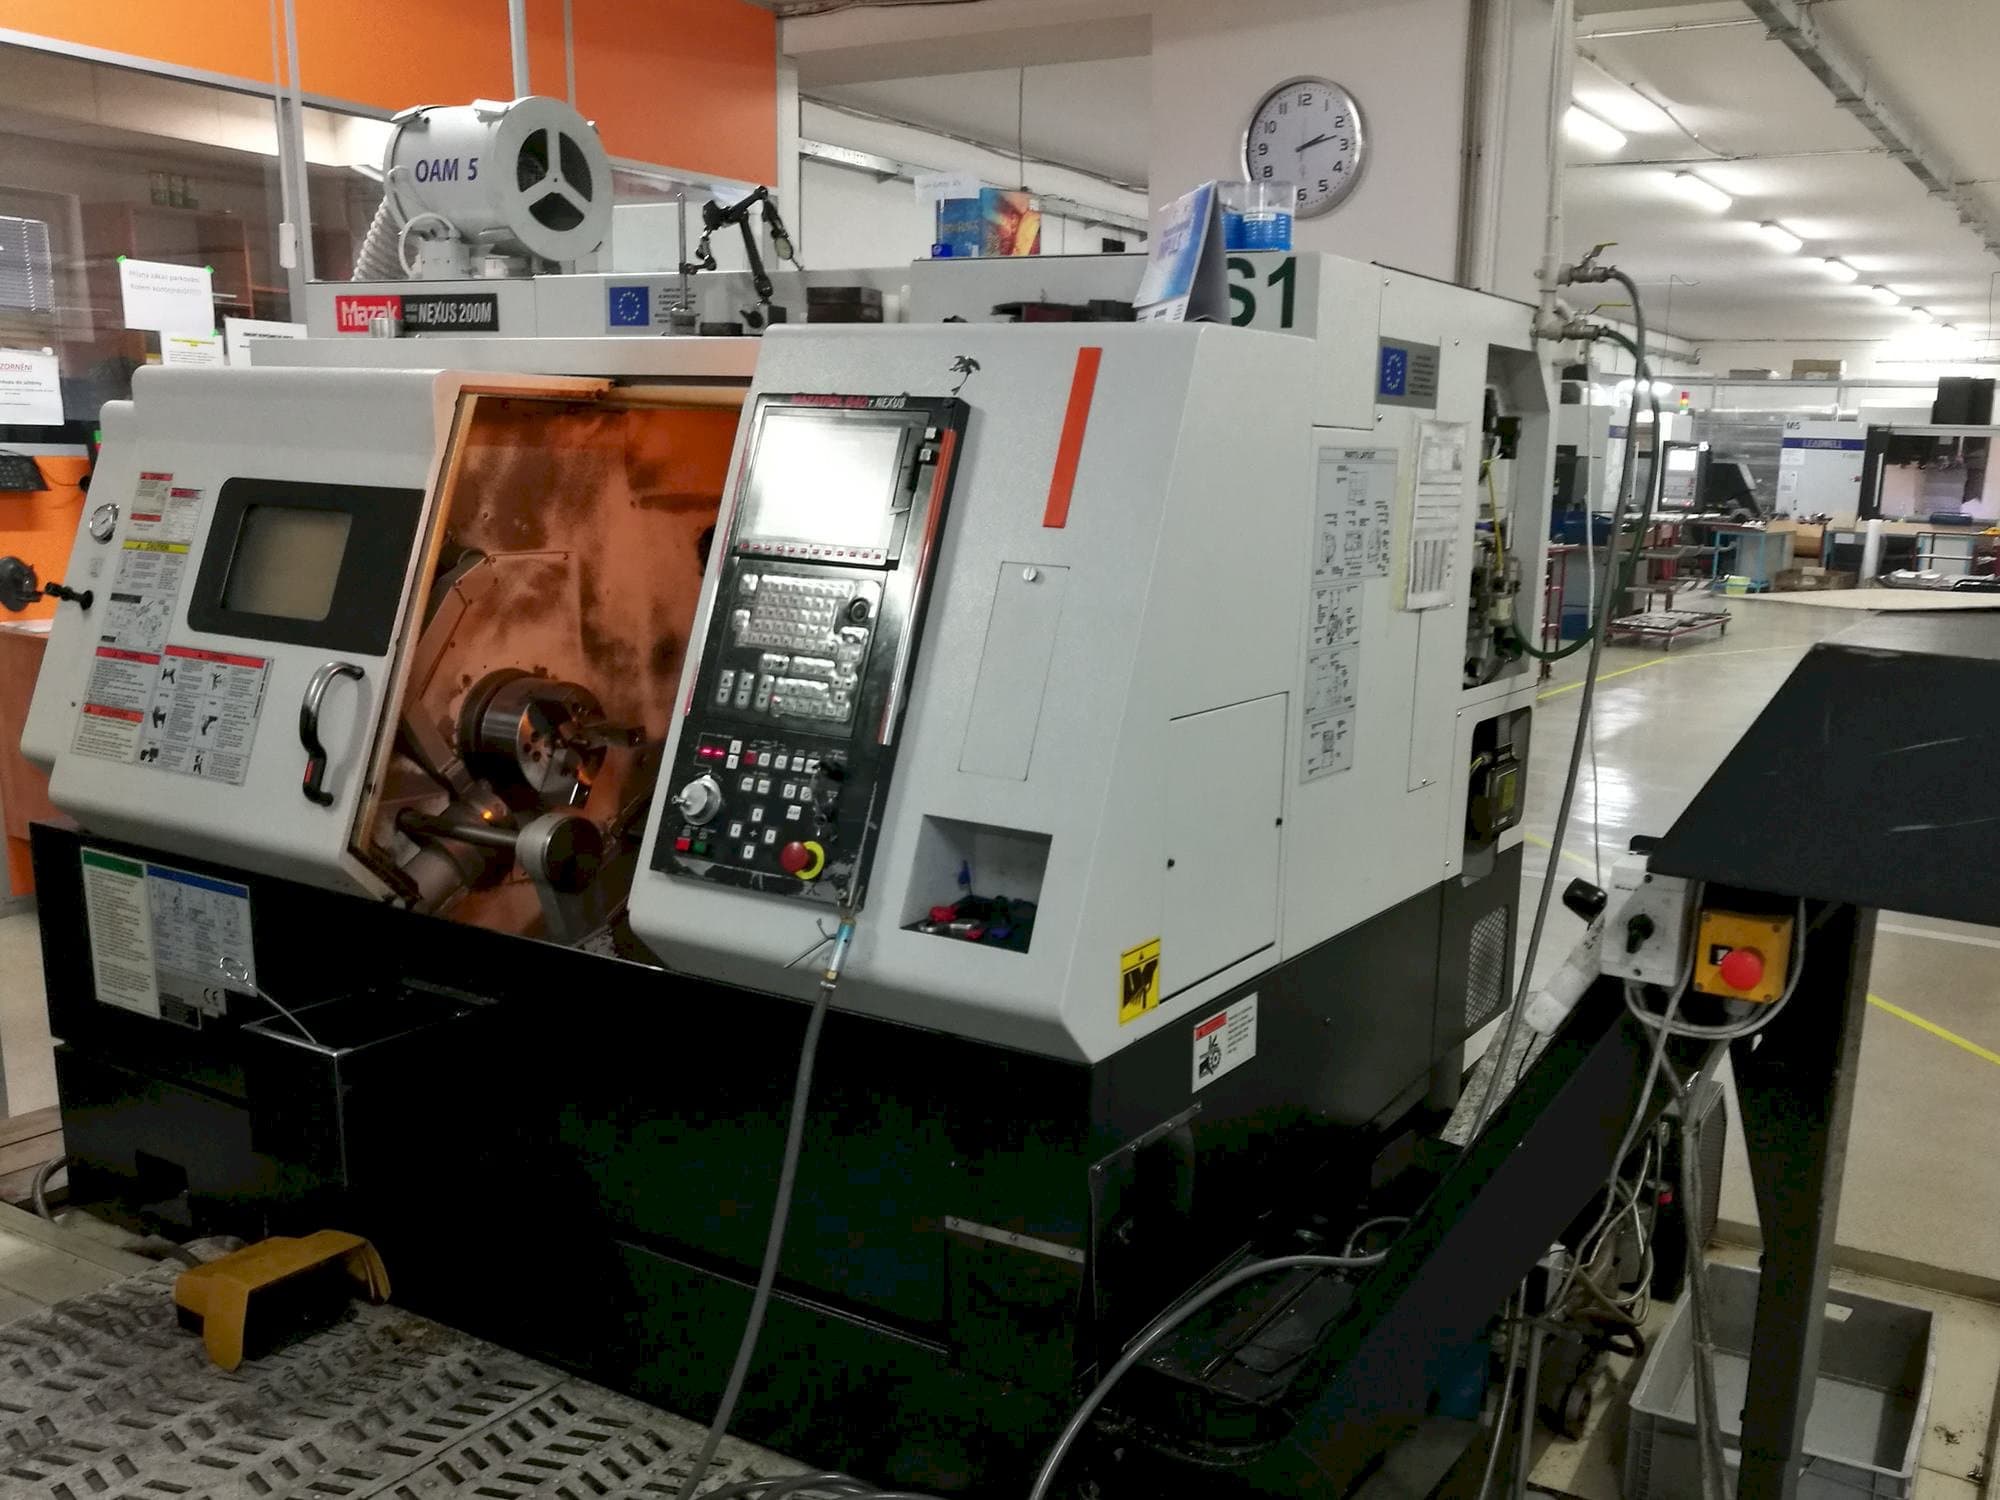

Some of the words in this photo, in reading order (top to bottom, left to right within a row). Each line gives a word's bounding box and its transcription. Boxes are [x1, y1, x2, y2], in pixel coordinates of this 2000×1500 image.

[1298, 93, 1312, 107] 12
[1324, 99, 1329, 112] 1
[1279, 102, 1288, 115] 11
[1264, 120, 1277, 134] 10
[1335, 115, 1345, 128] 2
[1258, 143, 1269, 156] 9
[1339, 138, 1349, 151] 3
[415, 158, 459, 183] OAM
[467, 157, 479, 181] 5
[1263, 165, 1273, 178] 8
[1332, 160, 1343, 173] 4
[1318, 179, 1329, 192] 5
[1297, 188, 1308, 201] 6
[1226, 256, 1297, 329] S1
[341, 300, 398, 326] Mazak
[419, 301, 458, 325] NEXUS
[459, 301, 493, 323] 200M
[875, 397, 907, 409] NEXUS
